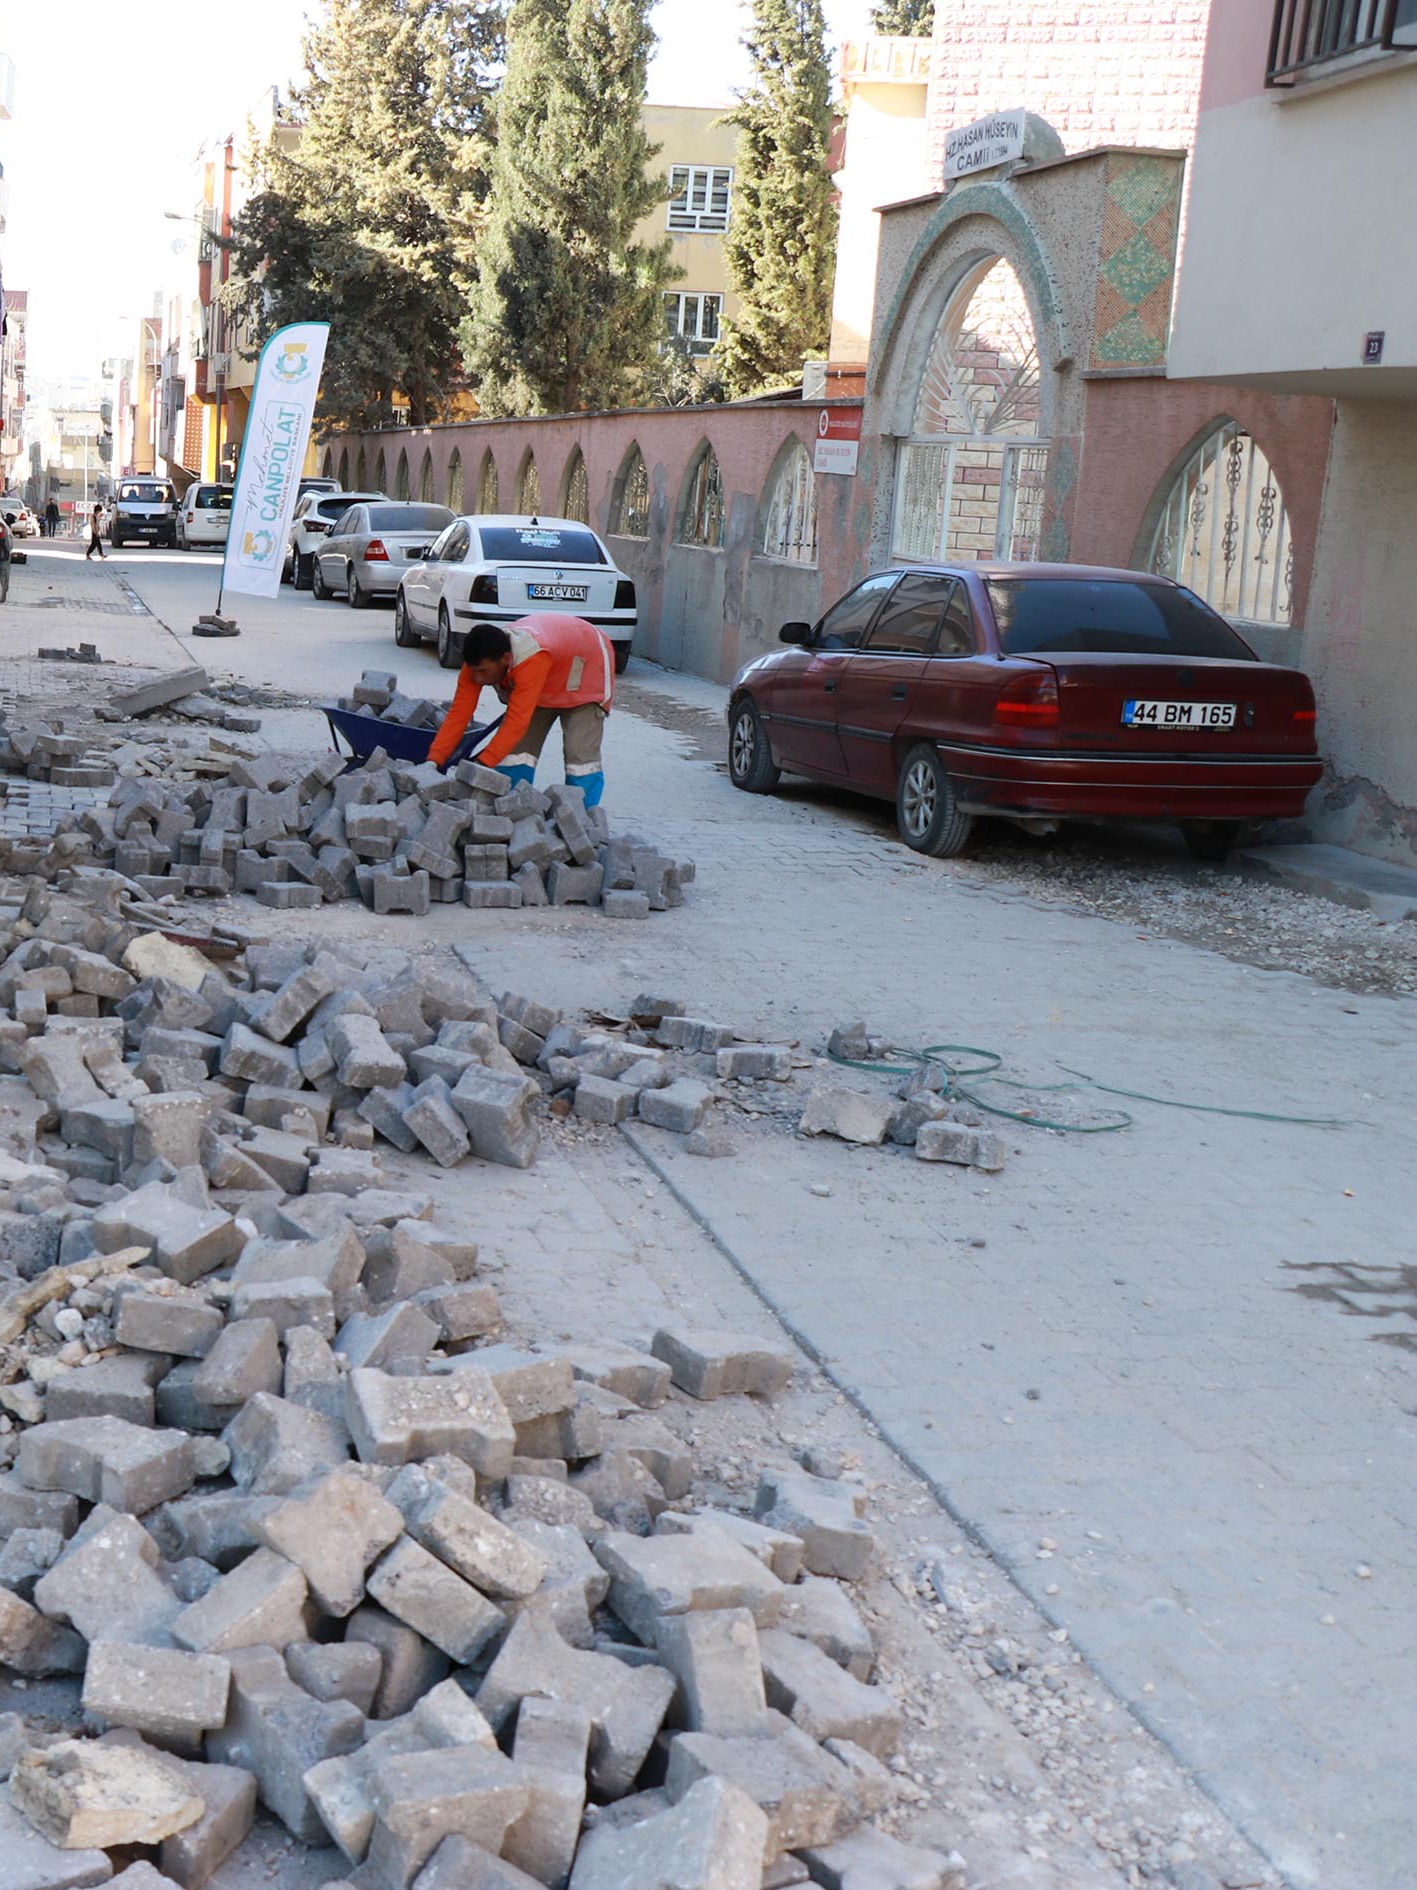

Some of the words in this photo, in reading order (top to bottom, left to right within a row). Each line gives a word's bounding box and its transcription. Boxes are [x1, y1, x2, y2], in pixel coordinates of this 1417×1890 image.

[957, 126, 984, 152] HASAN
[259, 407, 296, 522] CANPOLAT
[534, 586, 546, 596] 66
[548, 586, 569, 597] ACV
[569, 586, 585, 598] 041
[1133, 704, 1157, 722] 44
[1164, 705, 1192, 723] BM
[1200, 706, 1232, 724] 165
